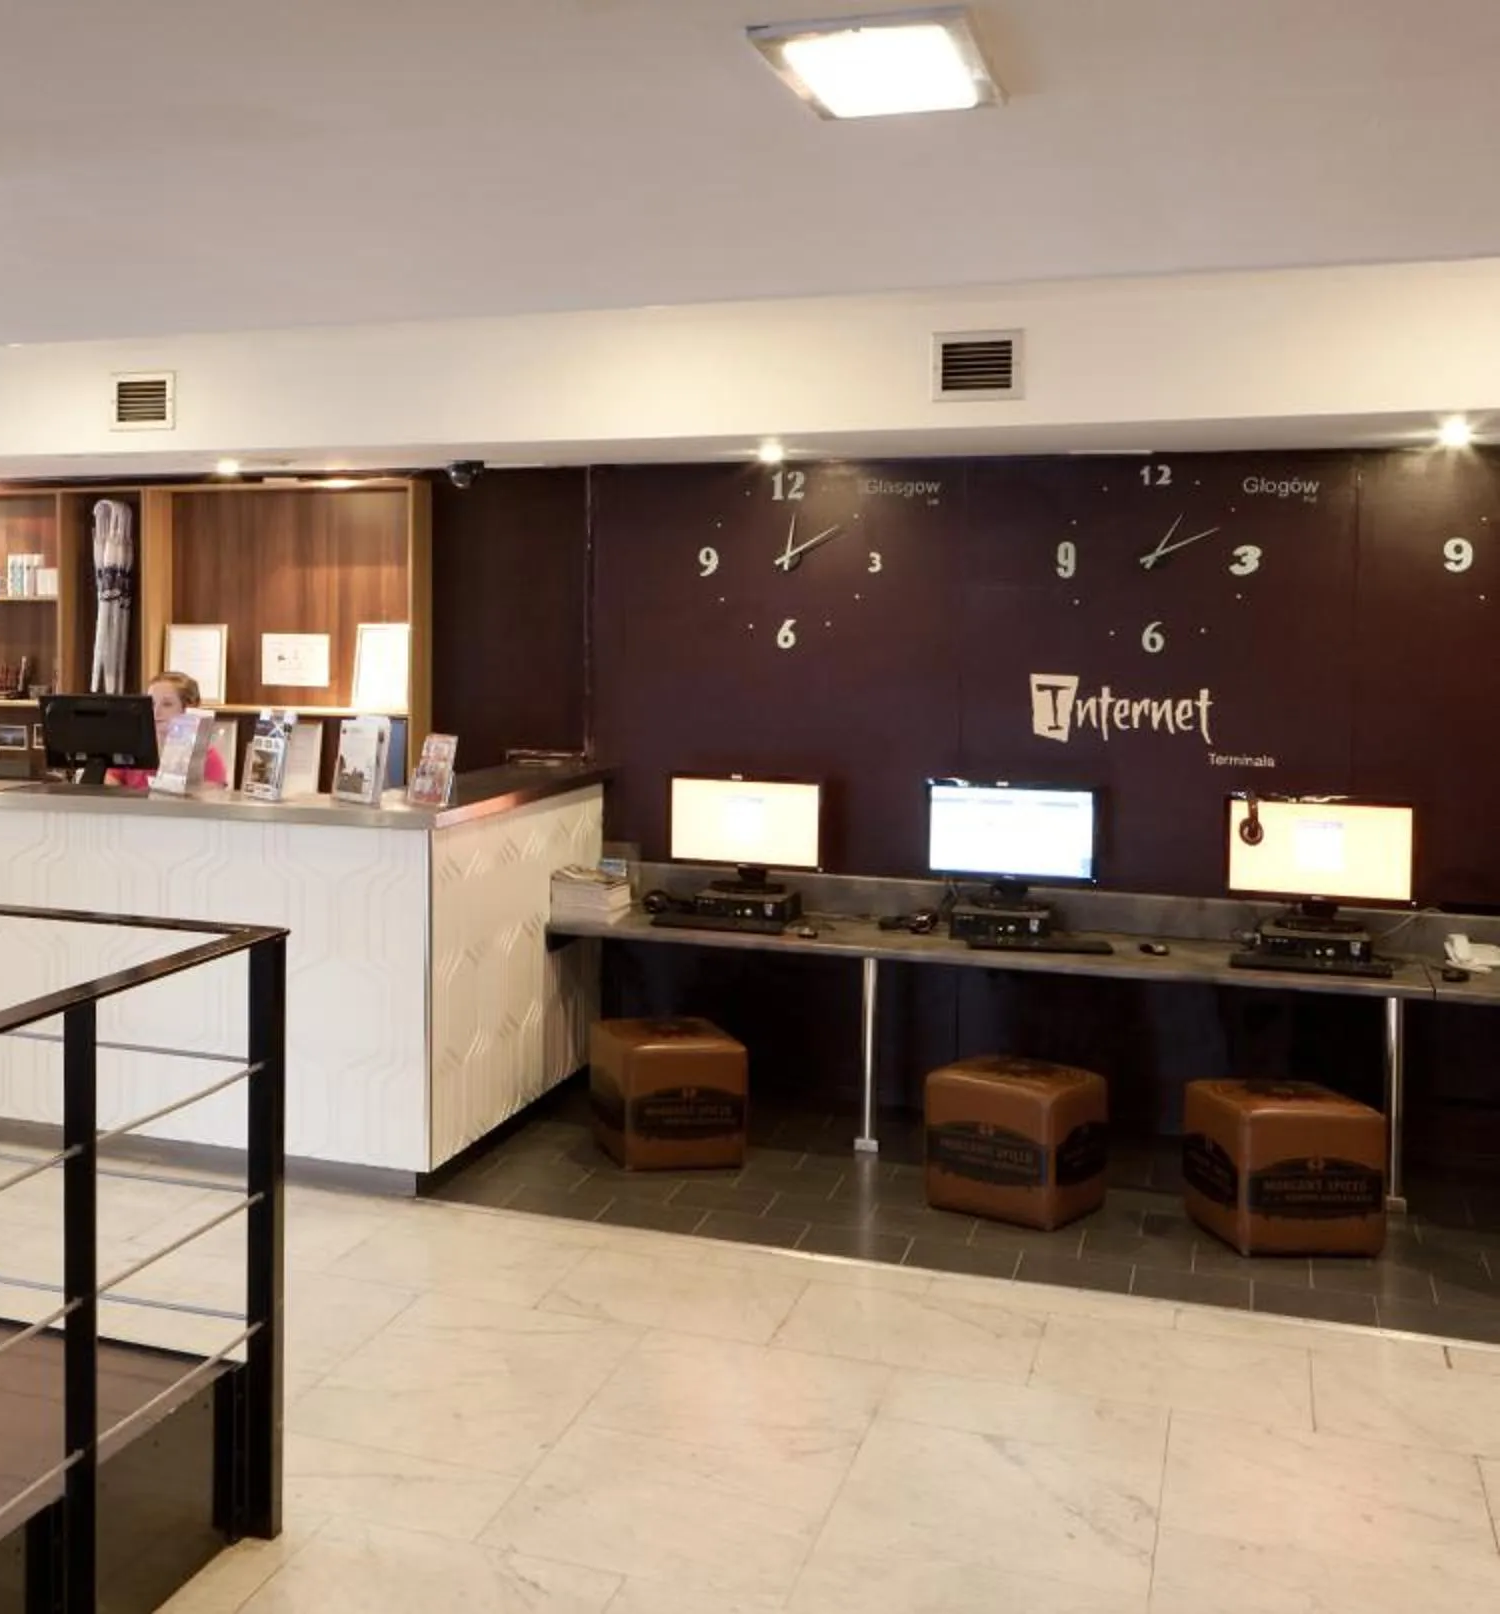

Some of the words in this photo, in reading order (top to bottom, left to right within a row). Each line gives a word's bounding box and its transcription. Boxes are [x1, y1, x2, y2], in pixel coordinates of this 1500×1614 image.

[771, 471, 805, 500] 12
[866, 478, 941, 498] Glasgow
[1139, 464, 1172, 486] 12
[699, 546, 719, 577] 9
[868, 551, 883, 573] 3
[1056, 541, 1077, 579] 9
[1229, 545, 1262, 576] 3
[1443, 537, 1474, 573] 9
[776, 618, 797, 649] 6
[1141, 621, 1165, 653] 6
[1030, 673, 1214, 744] Internet
[1207, 752, 1276, 768] Terminals
